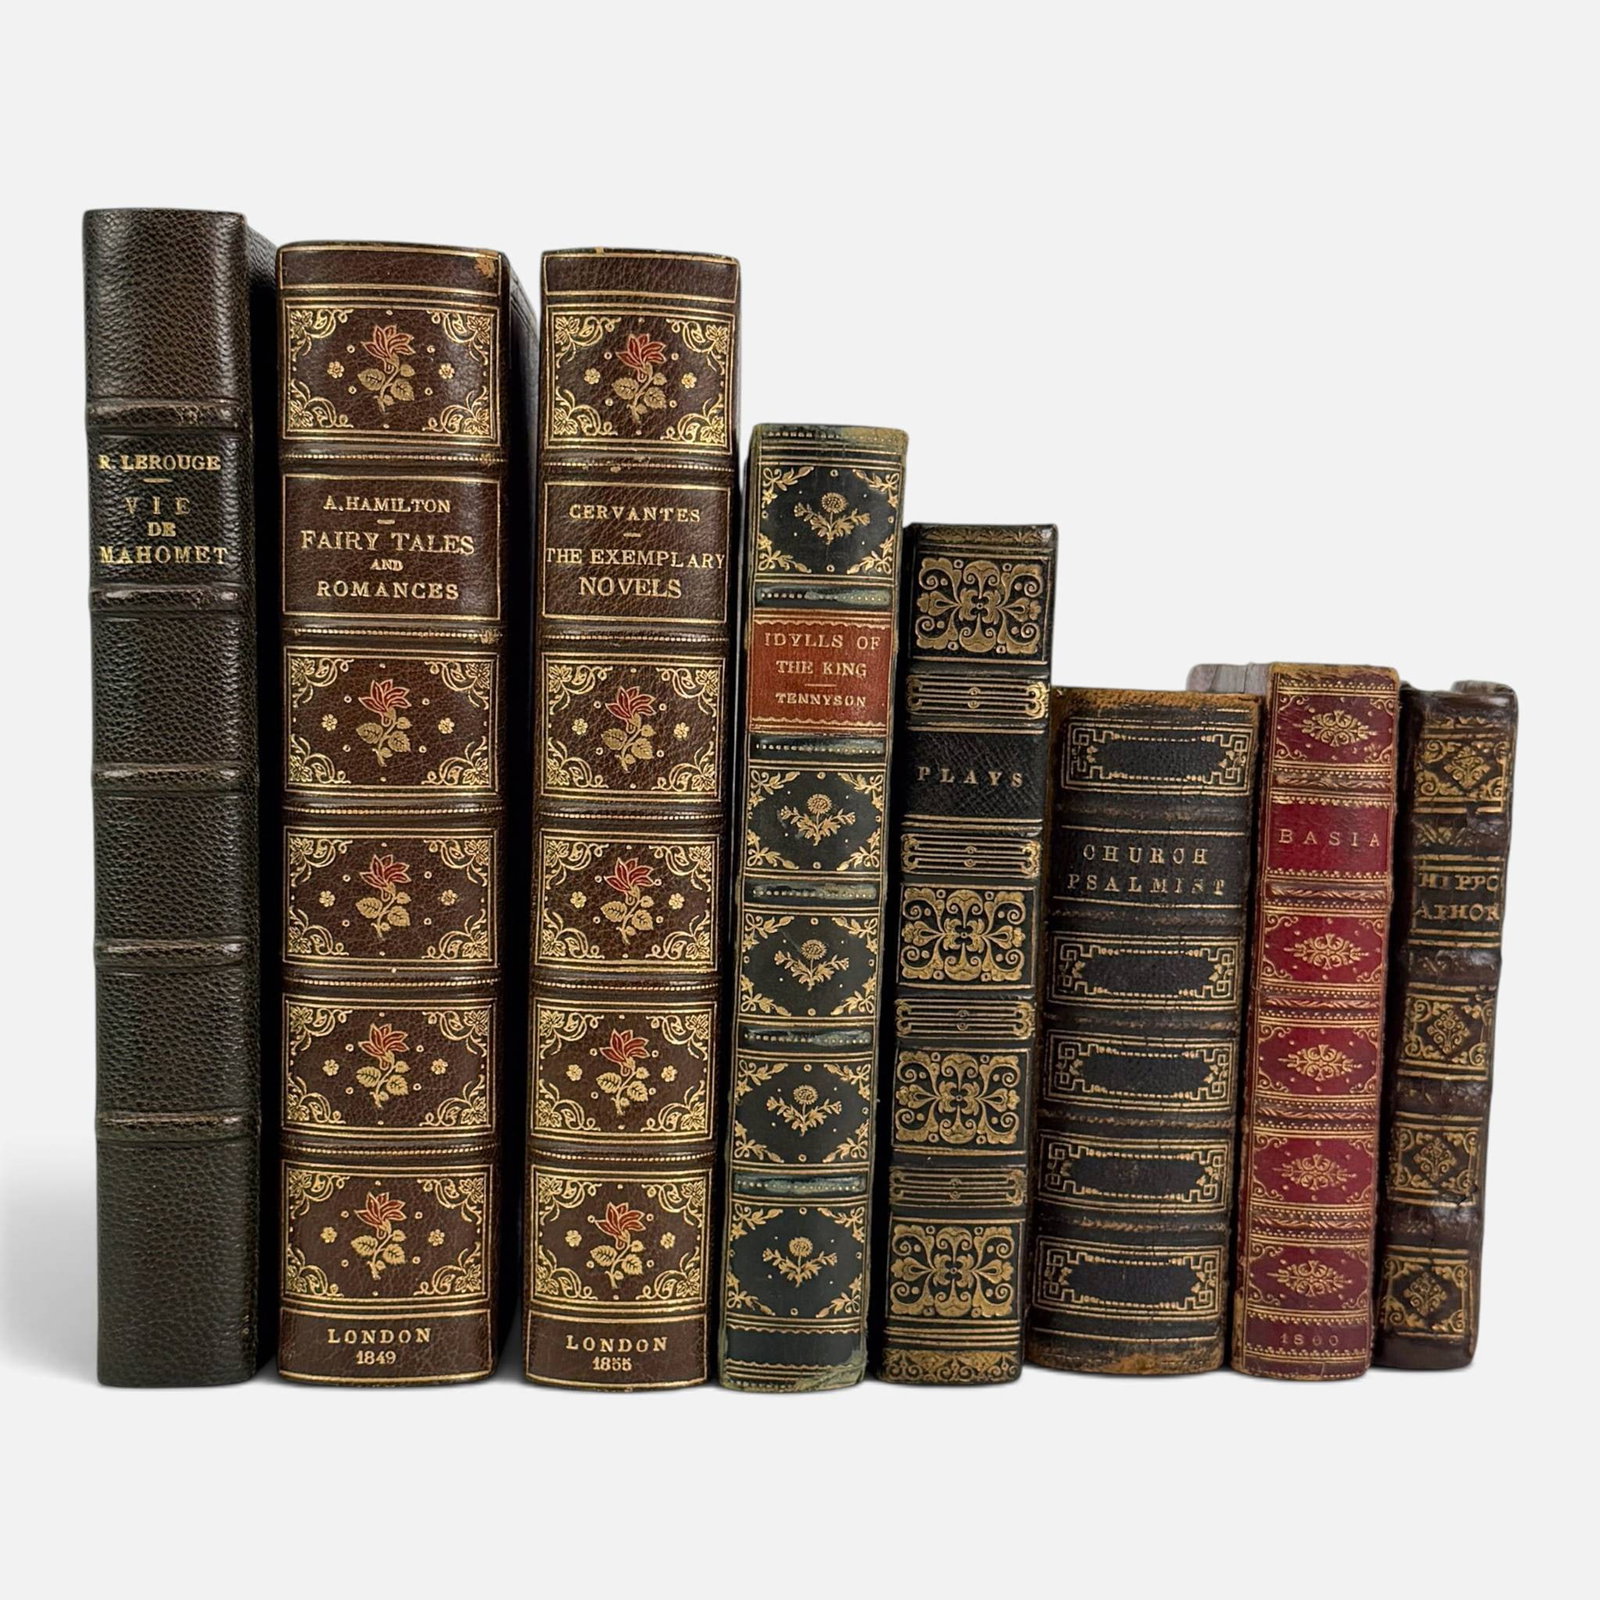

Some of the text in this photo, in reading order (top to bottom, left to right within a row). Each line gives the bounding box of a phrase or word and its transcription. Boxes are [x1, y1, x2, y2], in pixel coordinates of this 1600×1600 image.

[120, 454, 221, 471] LEROUGE
[124, 496, 190, 516] VIE
[569, 503, 701, 523] CERVANTES
[147, 521, 176, 537] DE
[301, 530, 475, 556] FAIRY TALES
[99, 545, 228, 564] MAHOMET
[546, 548, 725, 569] THE EXEMPLARY
[370, 558, 404, 572] AND
[316, 581, 459, 600] ROMANCES
[579, 577, 682, 599] NOVELS
[764, 632, 881, 650] IDYLLS OF
[775, 660, 867, 678] THE KING
[775, 692, 866, 708] TENNYSON
[917, 766, 1024, 788] PLAYS
[1278, 828, 1380, 847] BASIA
[1083, 844, 1209, 864] CHURCH
[327, 1328, 431, 1344] LONDON
[565, 1335, 668, 1353] LONDON
[356, 1350, 397, 1365] 1849
[592, 1356, 632, 1371] 1855
